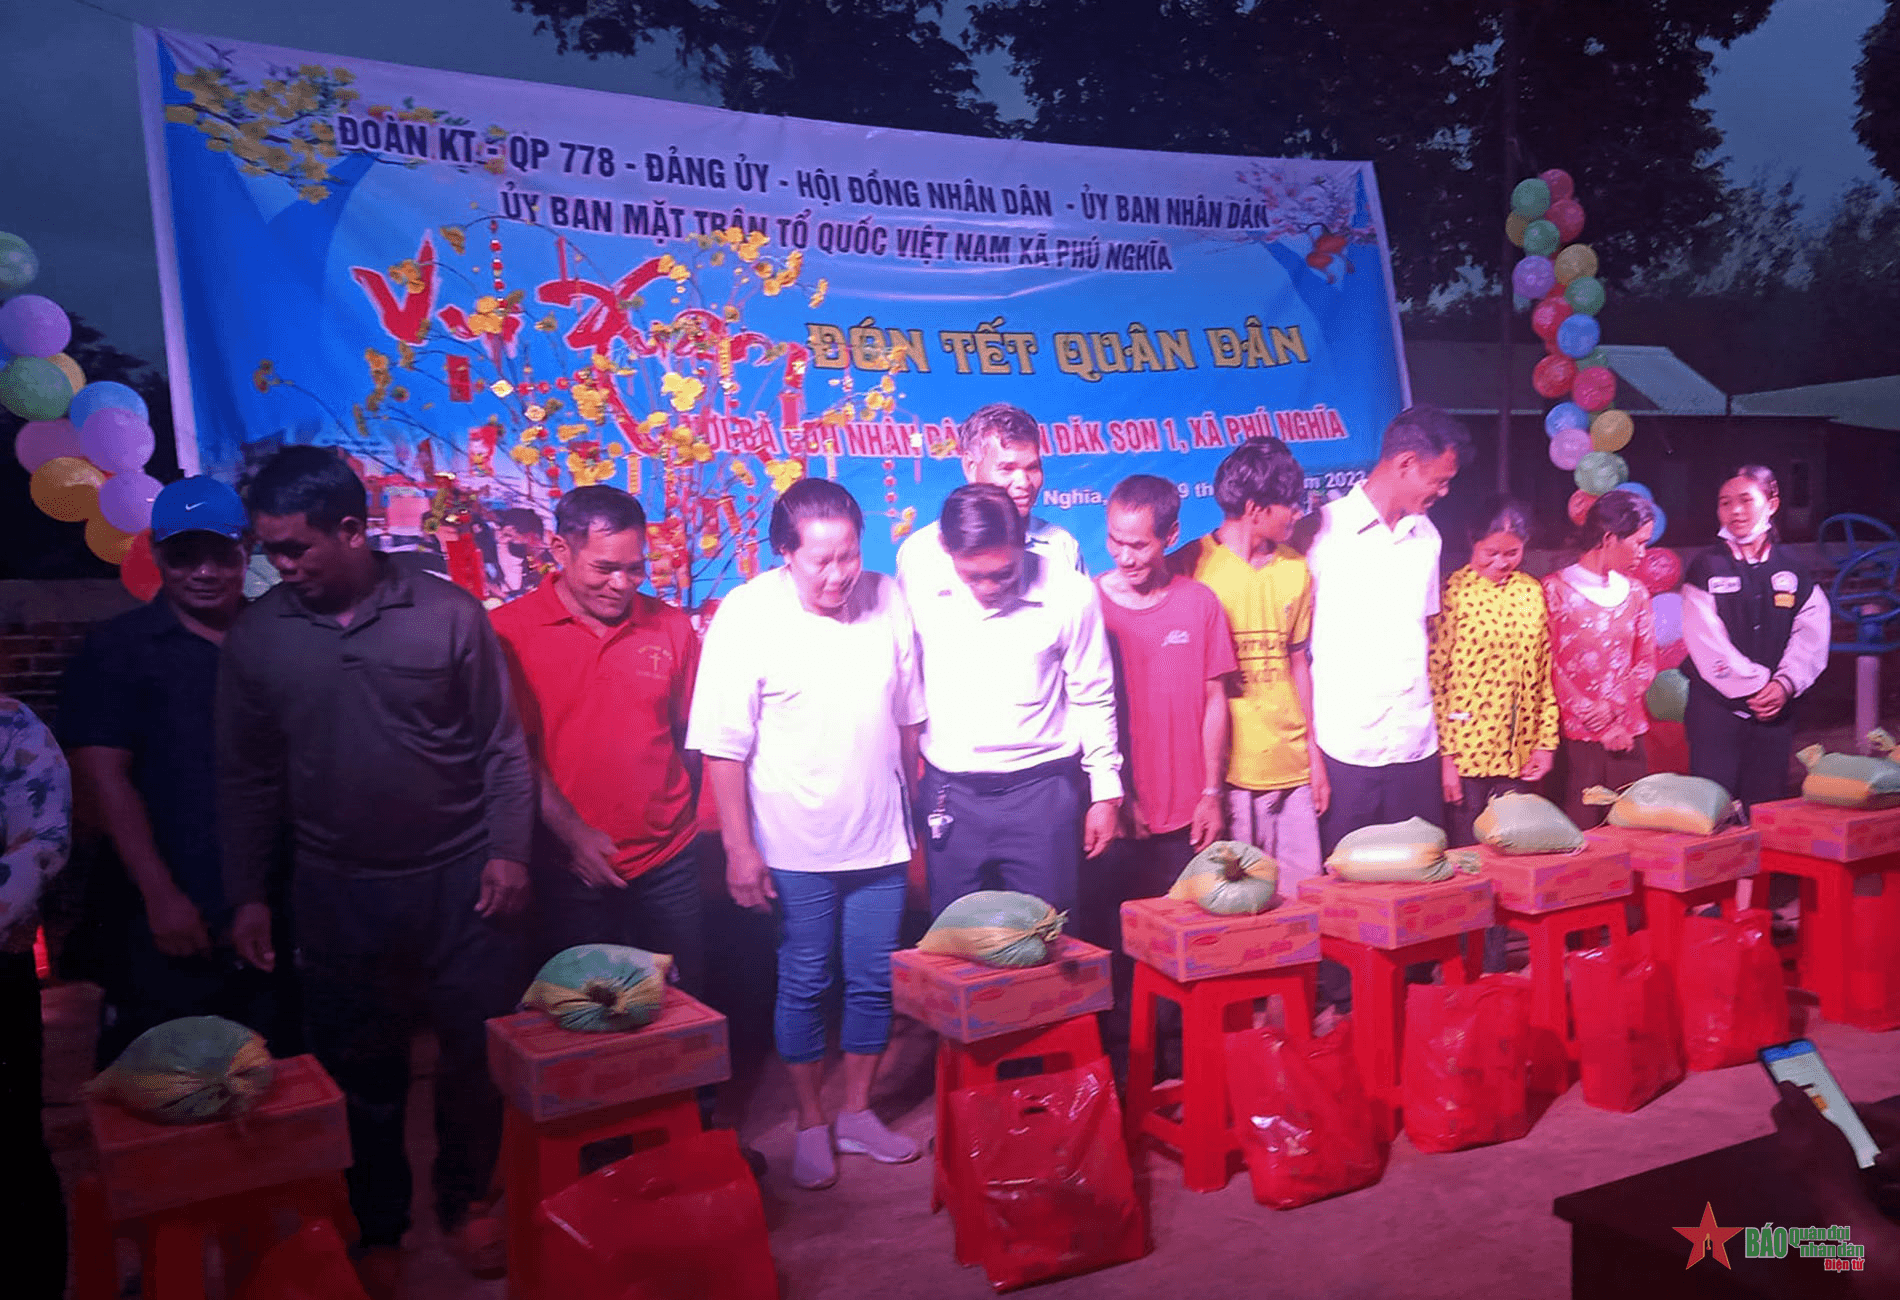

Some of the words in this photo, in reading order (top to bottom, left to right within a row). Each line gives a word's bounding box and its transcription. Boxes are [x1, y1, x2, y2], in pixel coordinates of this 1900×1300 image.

[337, 113, 427, 157] ĐOÀN
[439, 127, 476, 163] KT
[510, 135, 550, 172] QP
[559, 142, 615, 177] 778
[625, 162, 636, 170] -
[645, 145, 726, 189] ĐẢNG
[734, 153, 769, 193] ỦY
[779, 179, 789, 187] -
[796, 168, 841, 207] HỘI
[848, 168, 920, 207] ĐỒNG
[926, 178, 997, 213] NHÂN
[1002, 184, 1052, 217] DÂN
[1081, 183, 1108, 221] ỦY
[1115, 194, 1160, 224] BAN
[1167, 194, 1222, 228] NHÂN
[1227, 197, 1269, 229] DÂN
[501, 181, 539, 222] ỦY
[551, 196, 612, 233] BAN
[623, 200, 685, 244] MẶT
[777, 209, 812, 249] TỔ
[819, 215, 887, 255] QUỐC
[897, 225, 949, 265] VIỆT
[955, 232, 1011, 264] NAM
[1019, 232, 1048, 266] XÃ
[1056, 235, 1100, 269] PHÚ
[1106, 239, 1173, 271] NGHĨA
[805, 316, 931, 373] ĐÓN
[939, 316, 1038, 375] TẾT
[1053, 322, 1198, 382] QUÂN
[1204, 315, 1311, 369] DÂN
[850, 417, 923, 456] NHÂN
[926, 418, 962, 456] DÂ
[1189, 412, 1223, 446] XÃ
[1225, 407, 1272, 444] PHÚ
[1275, 404, 1346, 440] NGHĨA
